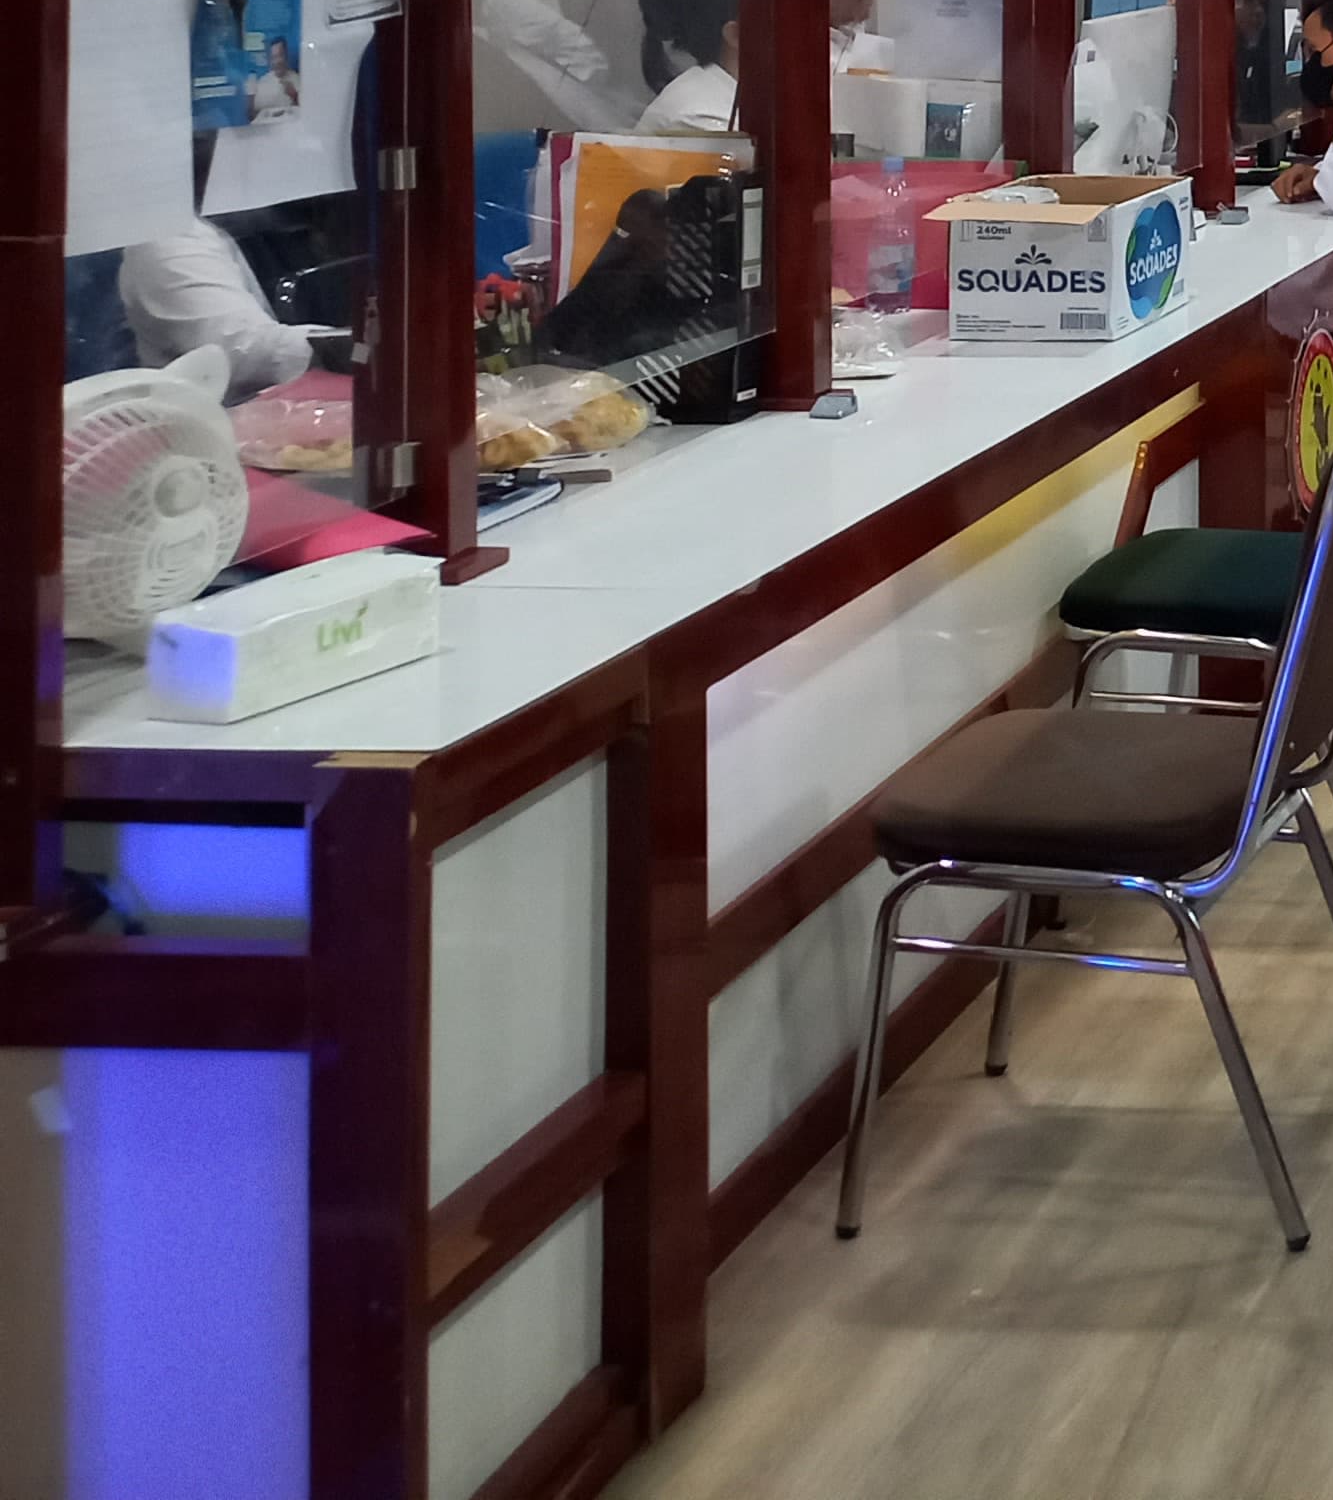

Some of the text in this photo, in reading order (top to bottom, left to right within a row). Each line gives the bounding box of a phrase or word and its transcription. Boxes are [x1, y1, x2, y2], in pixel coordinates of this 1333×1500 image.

[976, 225, 1012, 235] 240ml
[957, 269, 1106, 293] SQUADES
[1129, 243, 1178, 286] SQUADES
[317, 603, 368, 652] Livi
